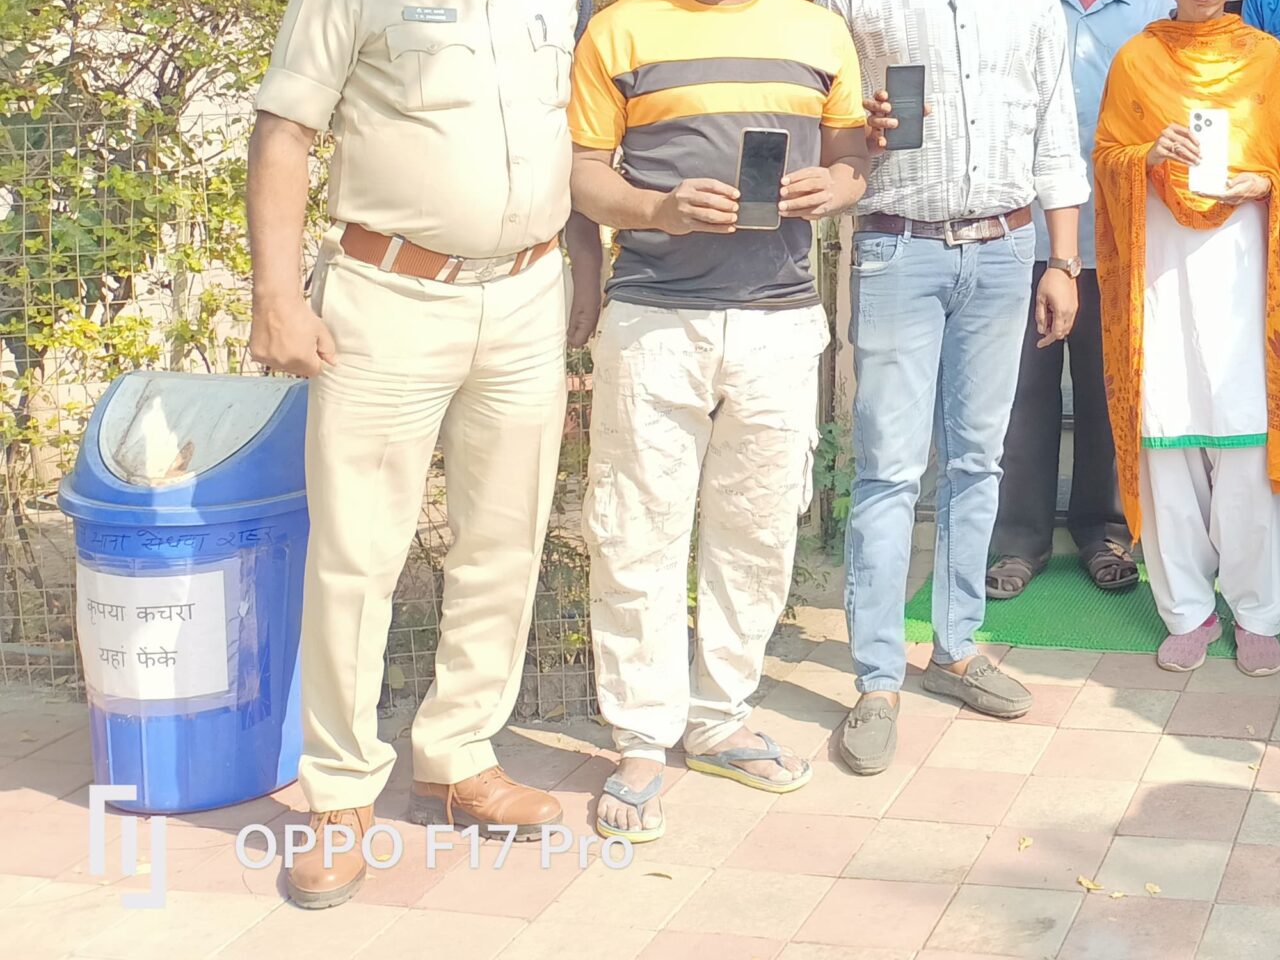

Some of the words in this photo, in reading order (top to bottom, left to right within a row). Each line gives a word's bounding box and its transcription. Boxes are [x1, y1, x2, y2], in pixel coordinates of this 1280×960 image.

[86, 597, 126, 625] कृपया
[136, 602, 196, 623] कचरा
[100, 645, 127, 669] यहां
[136, 646, 178, 669] फेंके
